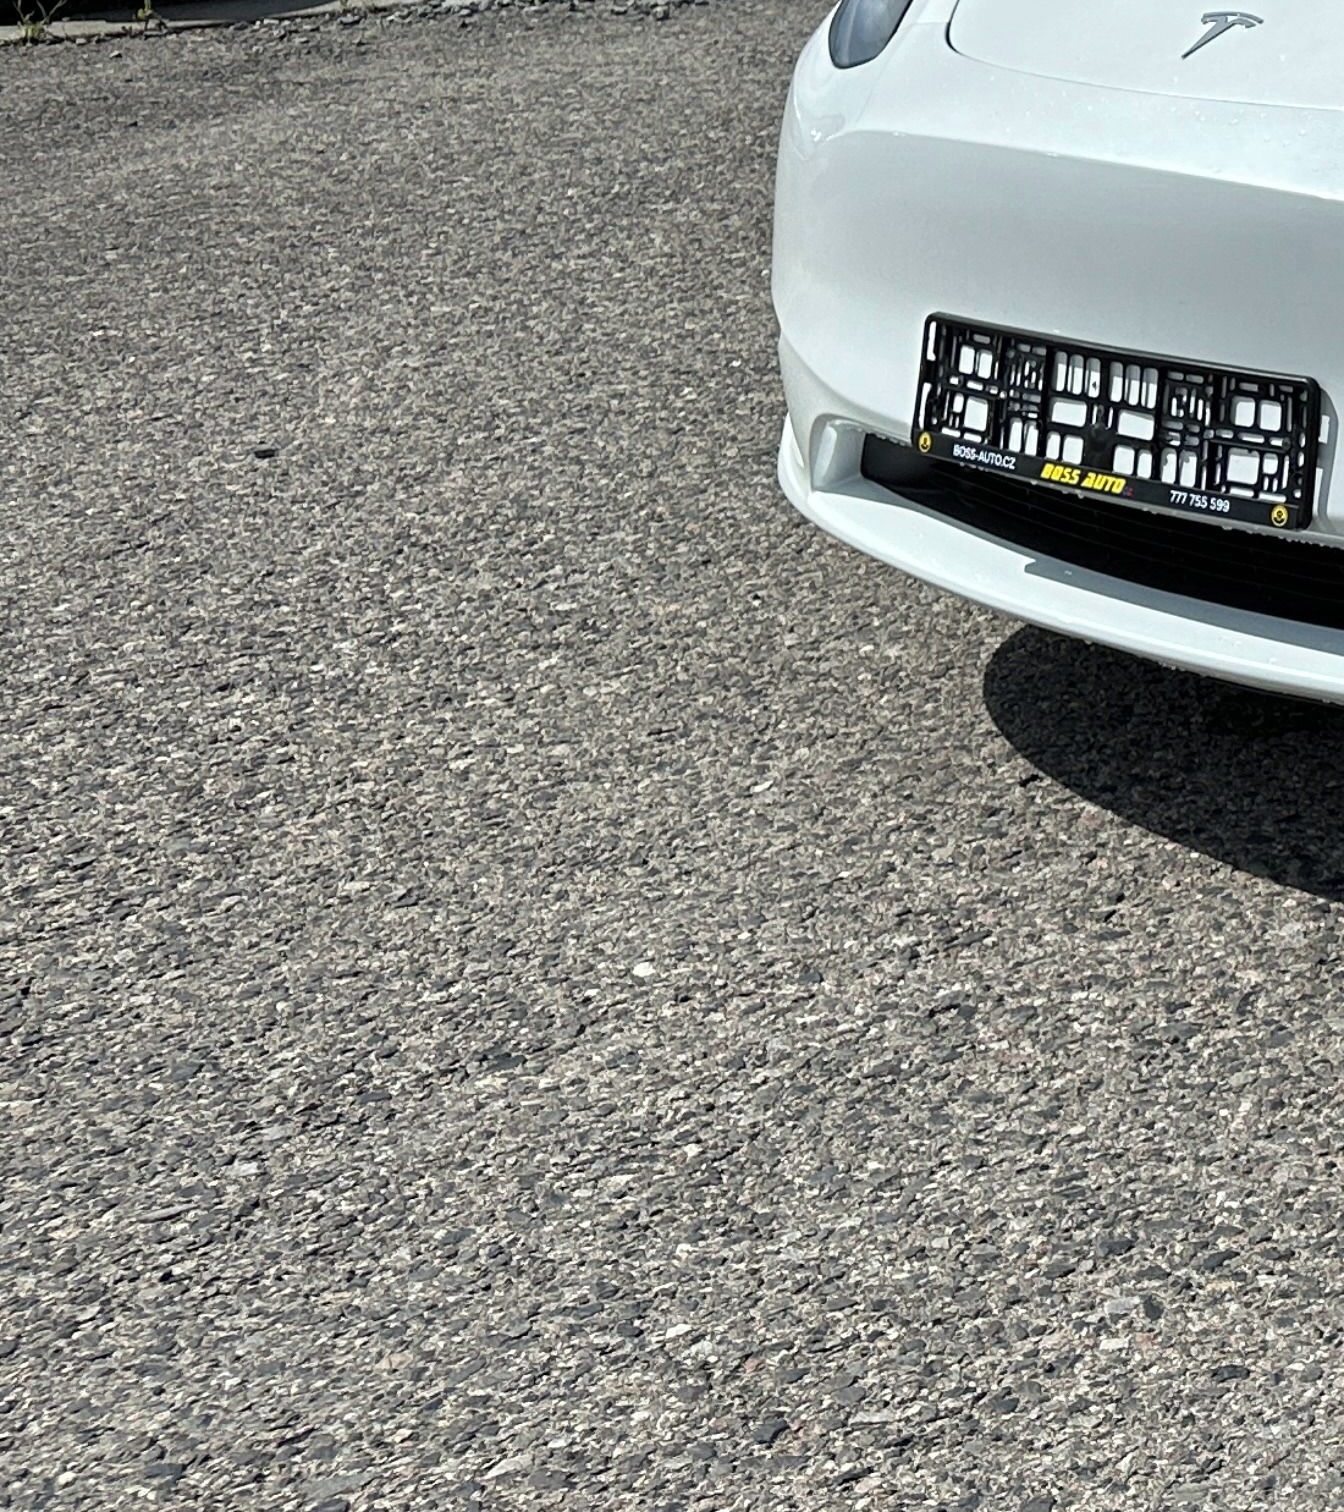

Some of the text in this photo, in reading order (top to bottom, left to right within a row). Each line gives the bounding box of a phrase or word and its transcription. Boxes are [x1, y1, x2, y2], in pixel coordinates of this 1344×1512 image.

[952, 443, 1016, 470] BOSS-AUTO.CZ
[1040, 462, 1081, 485] BOSS
[1082, 473, 1127, 494] AUTO
[1169, 490, 1189, 505] 777
[1189, 493, 1208, 508] 755
[1210, 497, 1231, 512] 599
